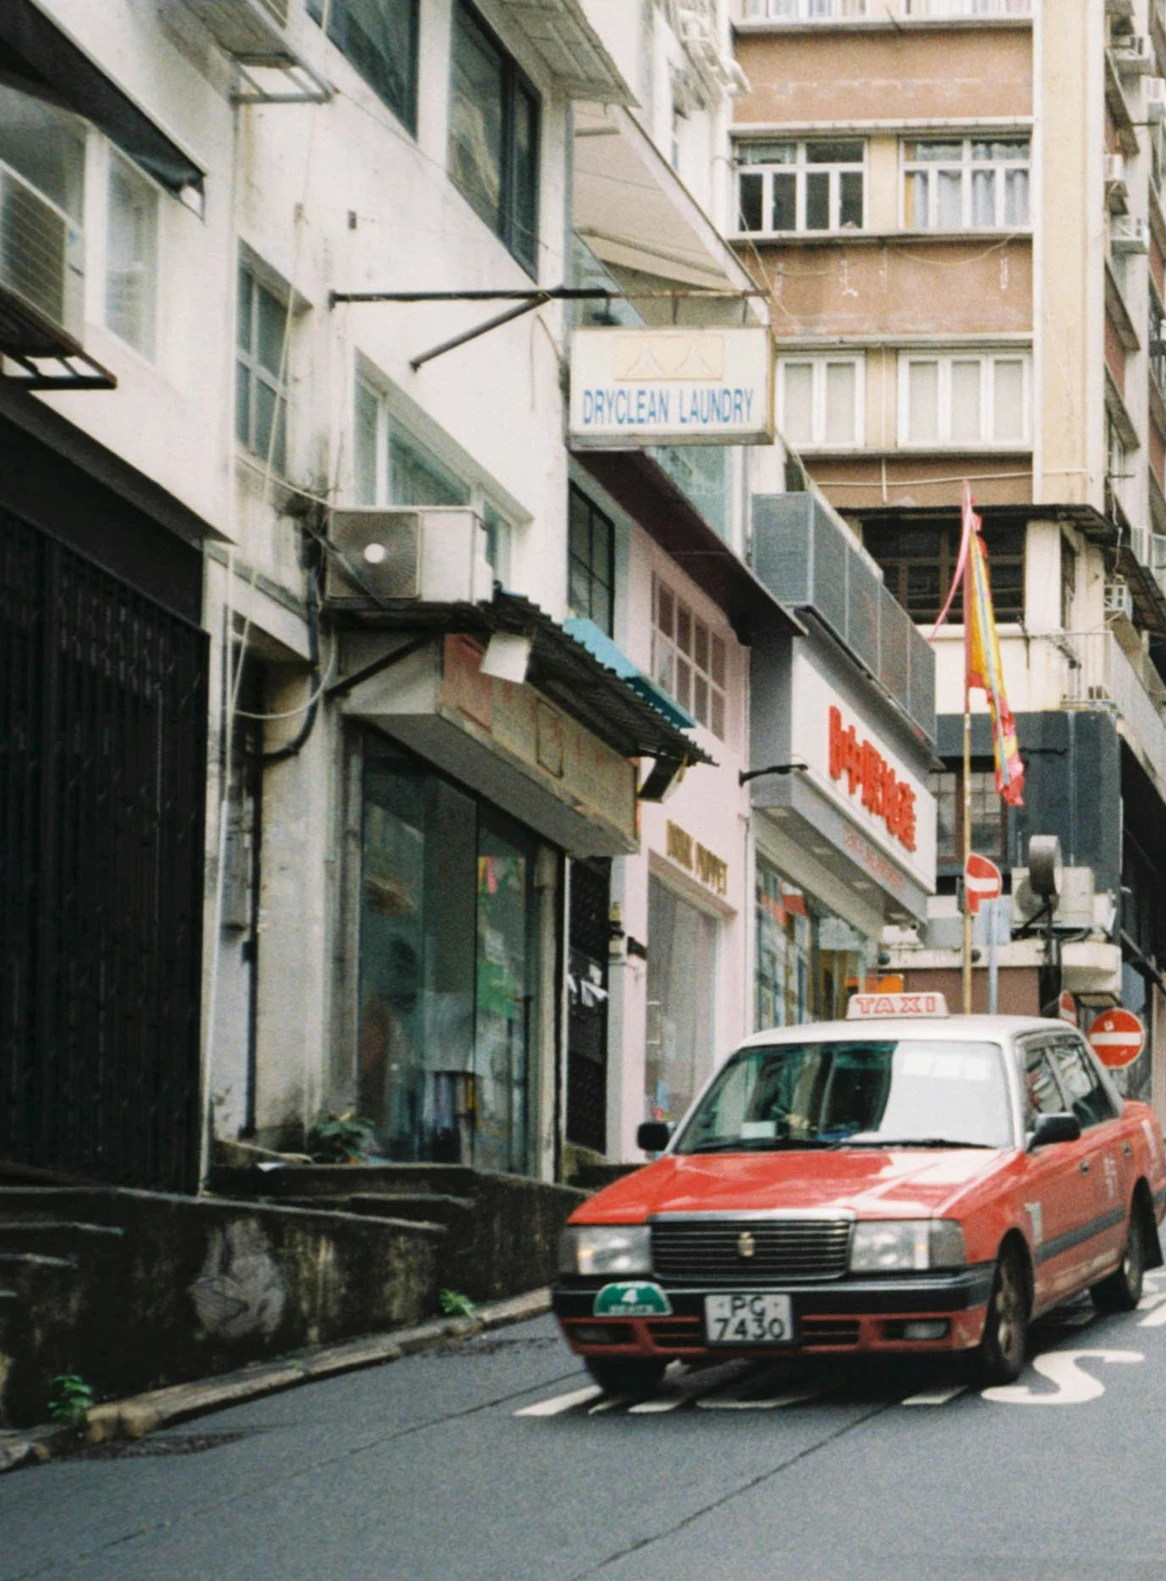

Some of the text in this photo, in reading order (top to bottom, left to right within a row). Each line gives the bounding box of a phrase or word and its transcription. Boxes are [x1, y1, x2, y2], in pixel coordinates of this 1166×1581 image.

[583, 387, 754, 425] DRYCLEAN LAUNDRY
[855, 995, 936, 1015] TAXI
[730, 1295, 767, 1317] PG
[714, 1317, 785, 1341] 7430
